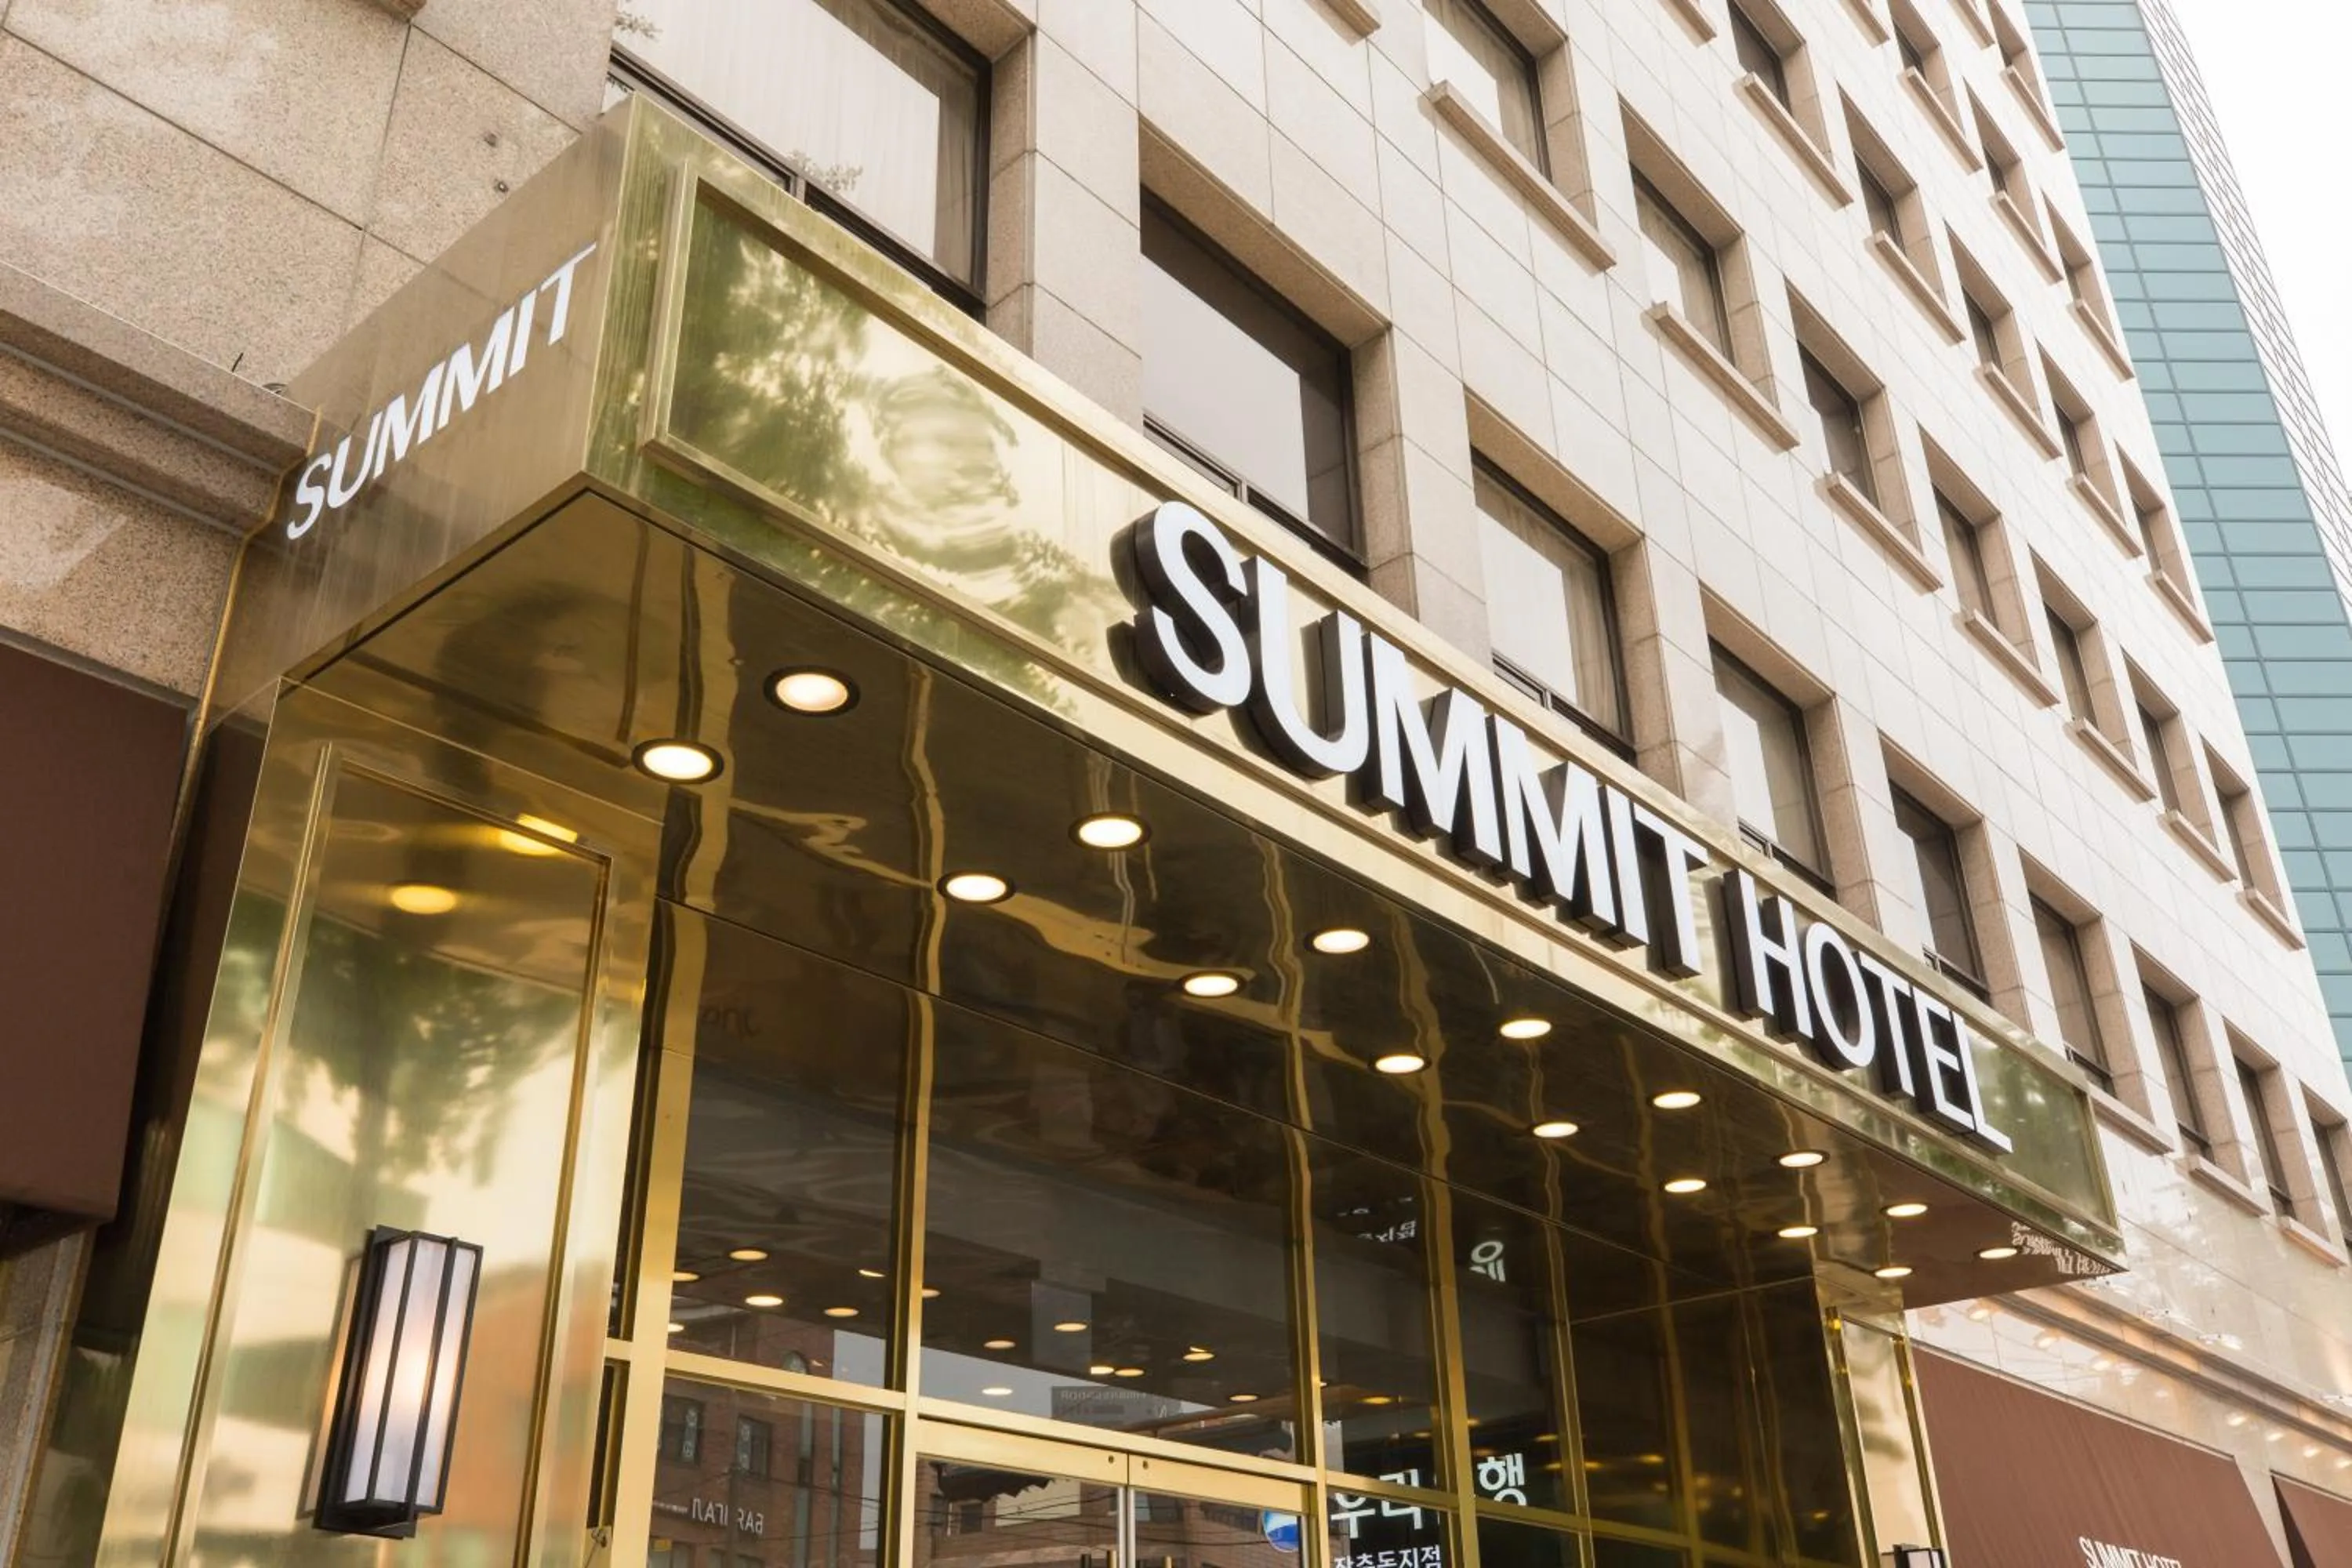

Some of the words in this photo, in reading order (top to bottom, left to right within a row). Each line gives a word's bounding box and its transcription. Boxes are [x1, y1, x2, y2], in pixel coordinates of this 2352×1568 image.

[287, 241, 597, 540] SUMMIT
[1143, 499, 1709, 978] SUMMIT
[1729, 867, 2013, 1155] HOTEL
